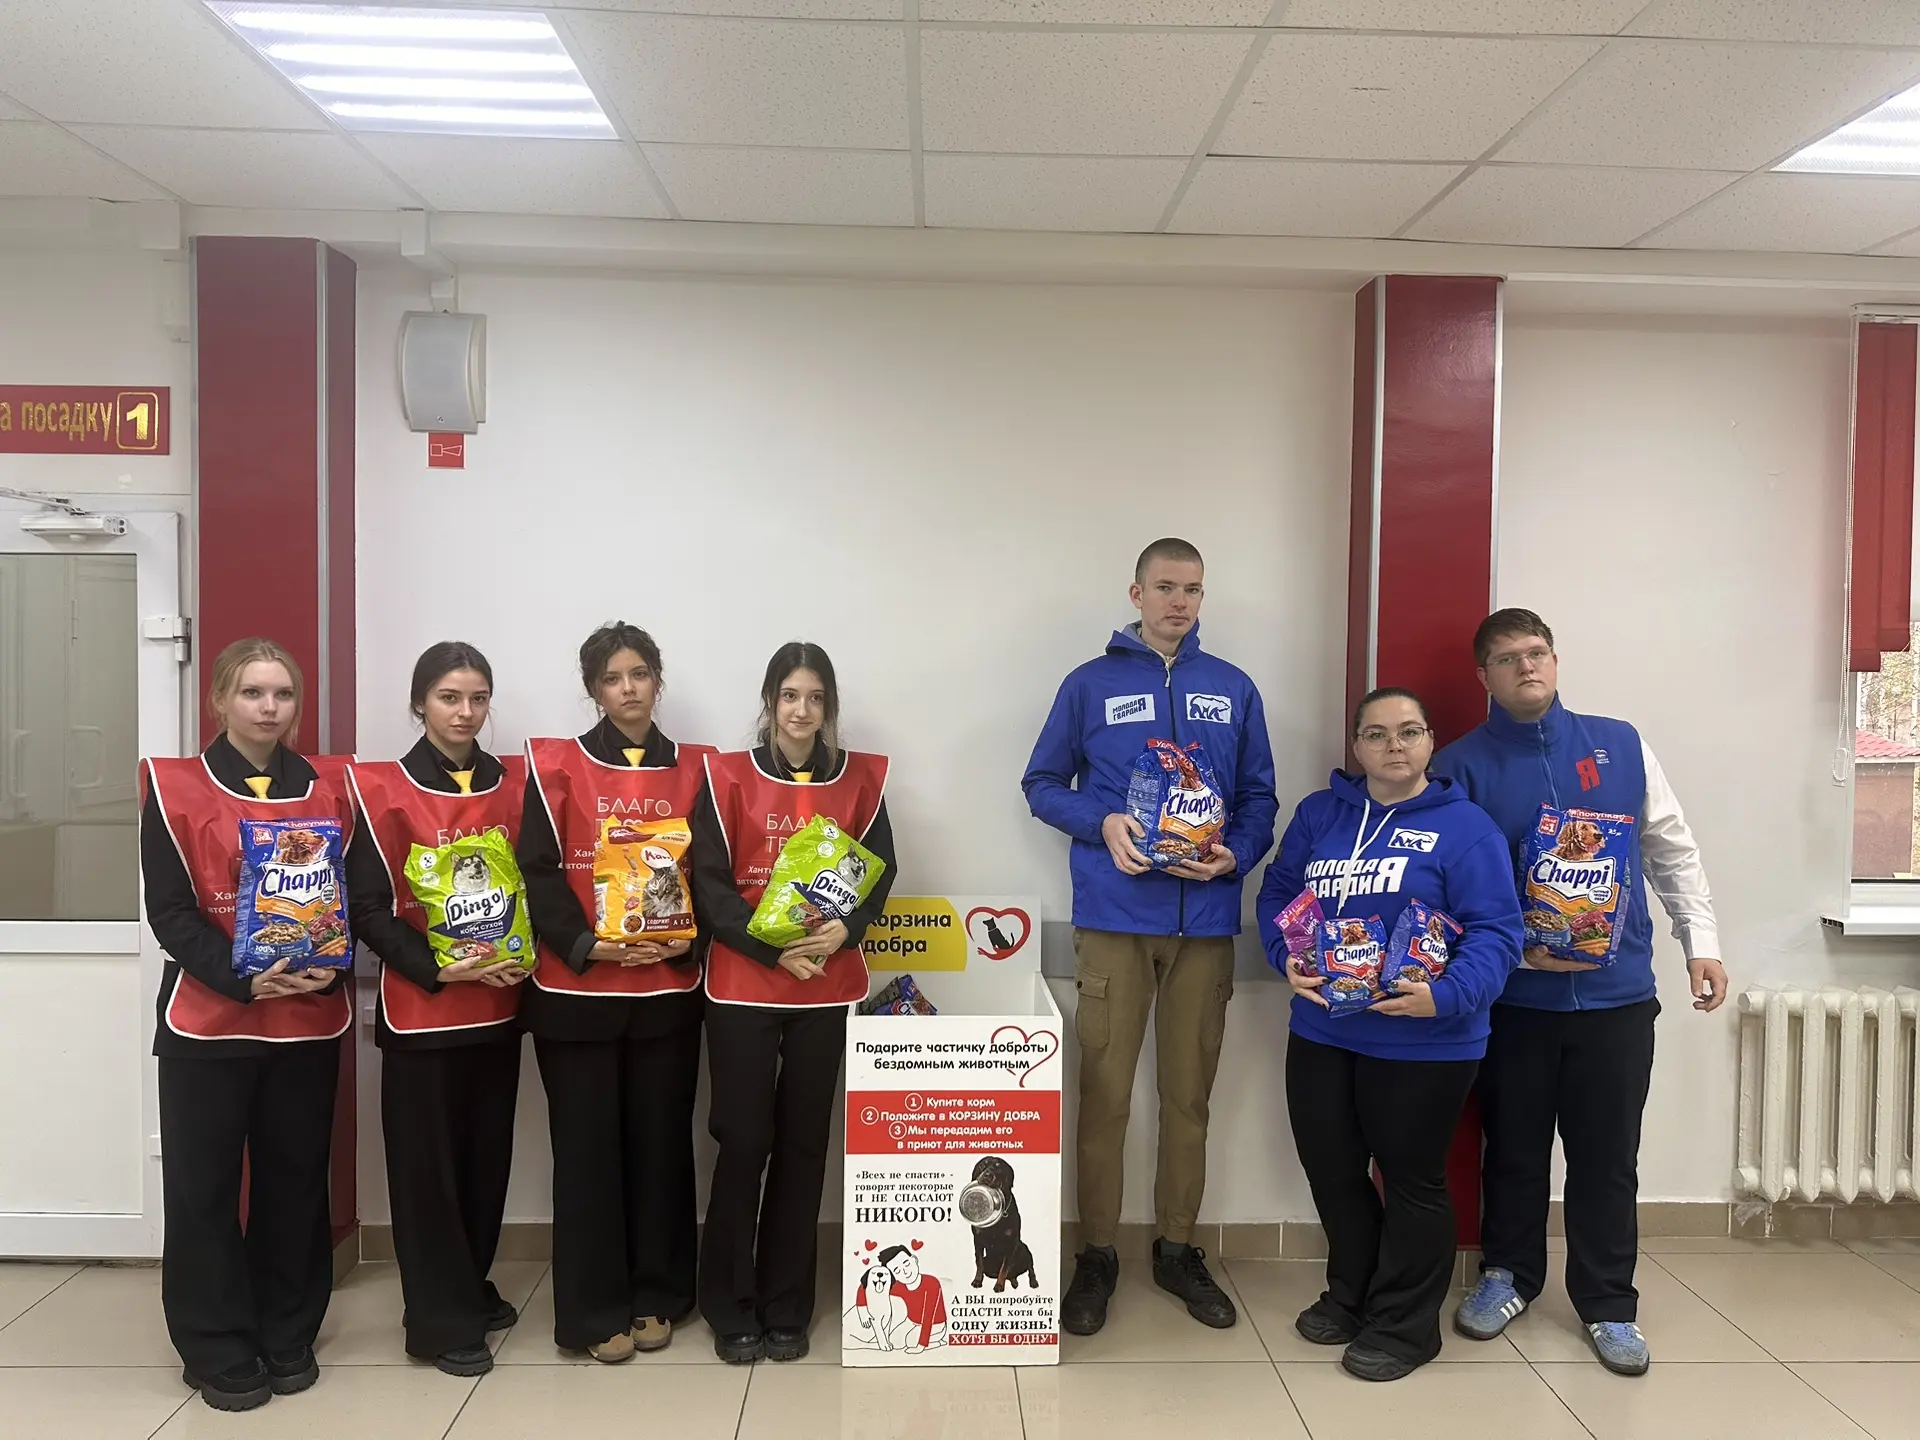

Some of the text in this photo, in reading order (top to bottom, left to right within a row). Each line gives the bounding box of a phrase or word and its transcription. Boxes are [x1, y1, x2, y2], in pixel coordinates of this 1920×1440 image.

[0, 401, 148, 442] а посадку 1
[1575, 756, 1601, 792] Я
[597, 796, 672, 817] БЛАГО
[1165, 792, 1216, 818] Chapp
[766, 813, 839, 832] БЛА
[574, 849, 595, 858] Хан
[1531, 858, 1610, 889] Chappi
[260, 868, 332, 897] Chappi
[214, 891, 238, 901] Хан
[815, 876, 857, 906] Dingo
[450, 893, 501, 922] Dingo
[863, 936, 928, 957] добра
[1334, 944, 1377, 962] Chappi
[1420, 937, 1449, 960] Chapp
[856, 1041, 1048, 1055] Подарите частичку доброты
[874, 1057, 1030, 1071] бездомным животным
[926, 1097, 964, 1108] Купите
[967, 1099, 996, 1108] корм
[880, 1111, 936, 1122] Положите
[938, 1113, 945, 1121] в
[949, 1111, 1001, 1121] КОРЗИНУ
[1003, 1111, 1041, 1122] ДОБРА
[907, 1125, 927, 1135] Мы
[930, 1127, 993, 1137] передадим
[995, 1127, 1014, 1136] его
[897, 1140, 1024, 1151] в приют для животных
[855, 1170, 886, 1180] «Всех
[889, 1172, 902, 1180] не
[905, 1172, 946, 1180] спасти»
[855, 1183, 954, 1193] говорят некоторые
[855, 1192, 954, 1203] И НЕ СПАСАЮТ
[855, 1207, 952, 1223] НИКОГО!
[951, 1294, 1054, 1307] А ВЫ попробуйте
[951, 1307, 1002, 1317] СПАСТИ
[1037, 1307, 1053, 1317] бы
[995, 1317, 1053, 1330] жизнь!
[950, 1333, 1054, 1345] ХОТЯ БЫ ОДНУ!
